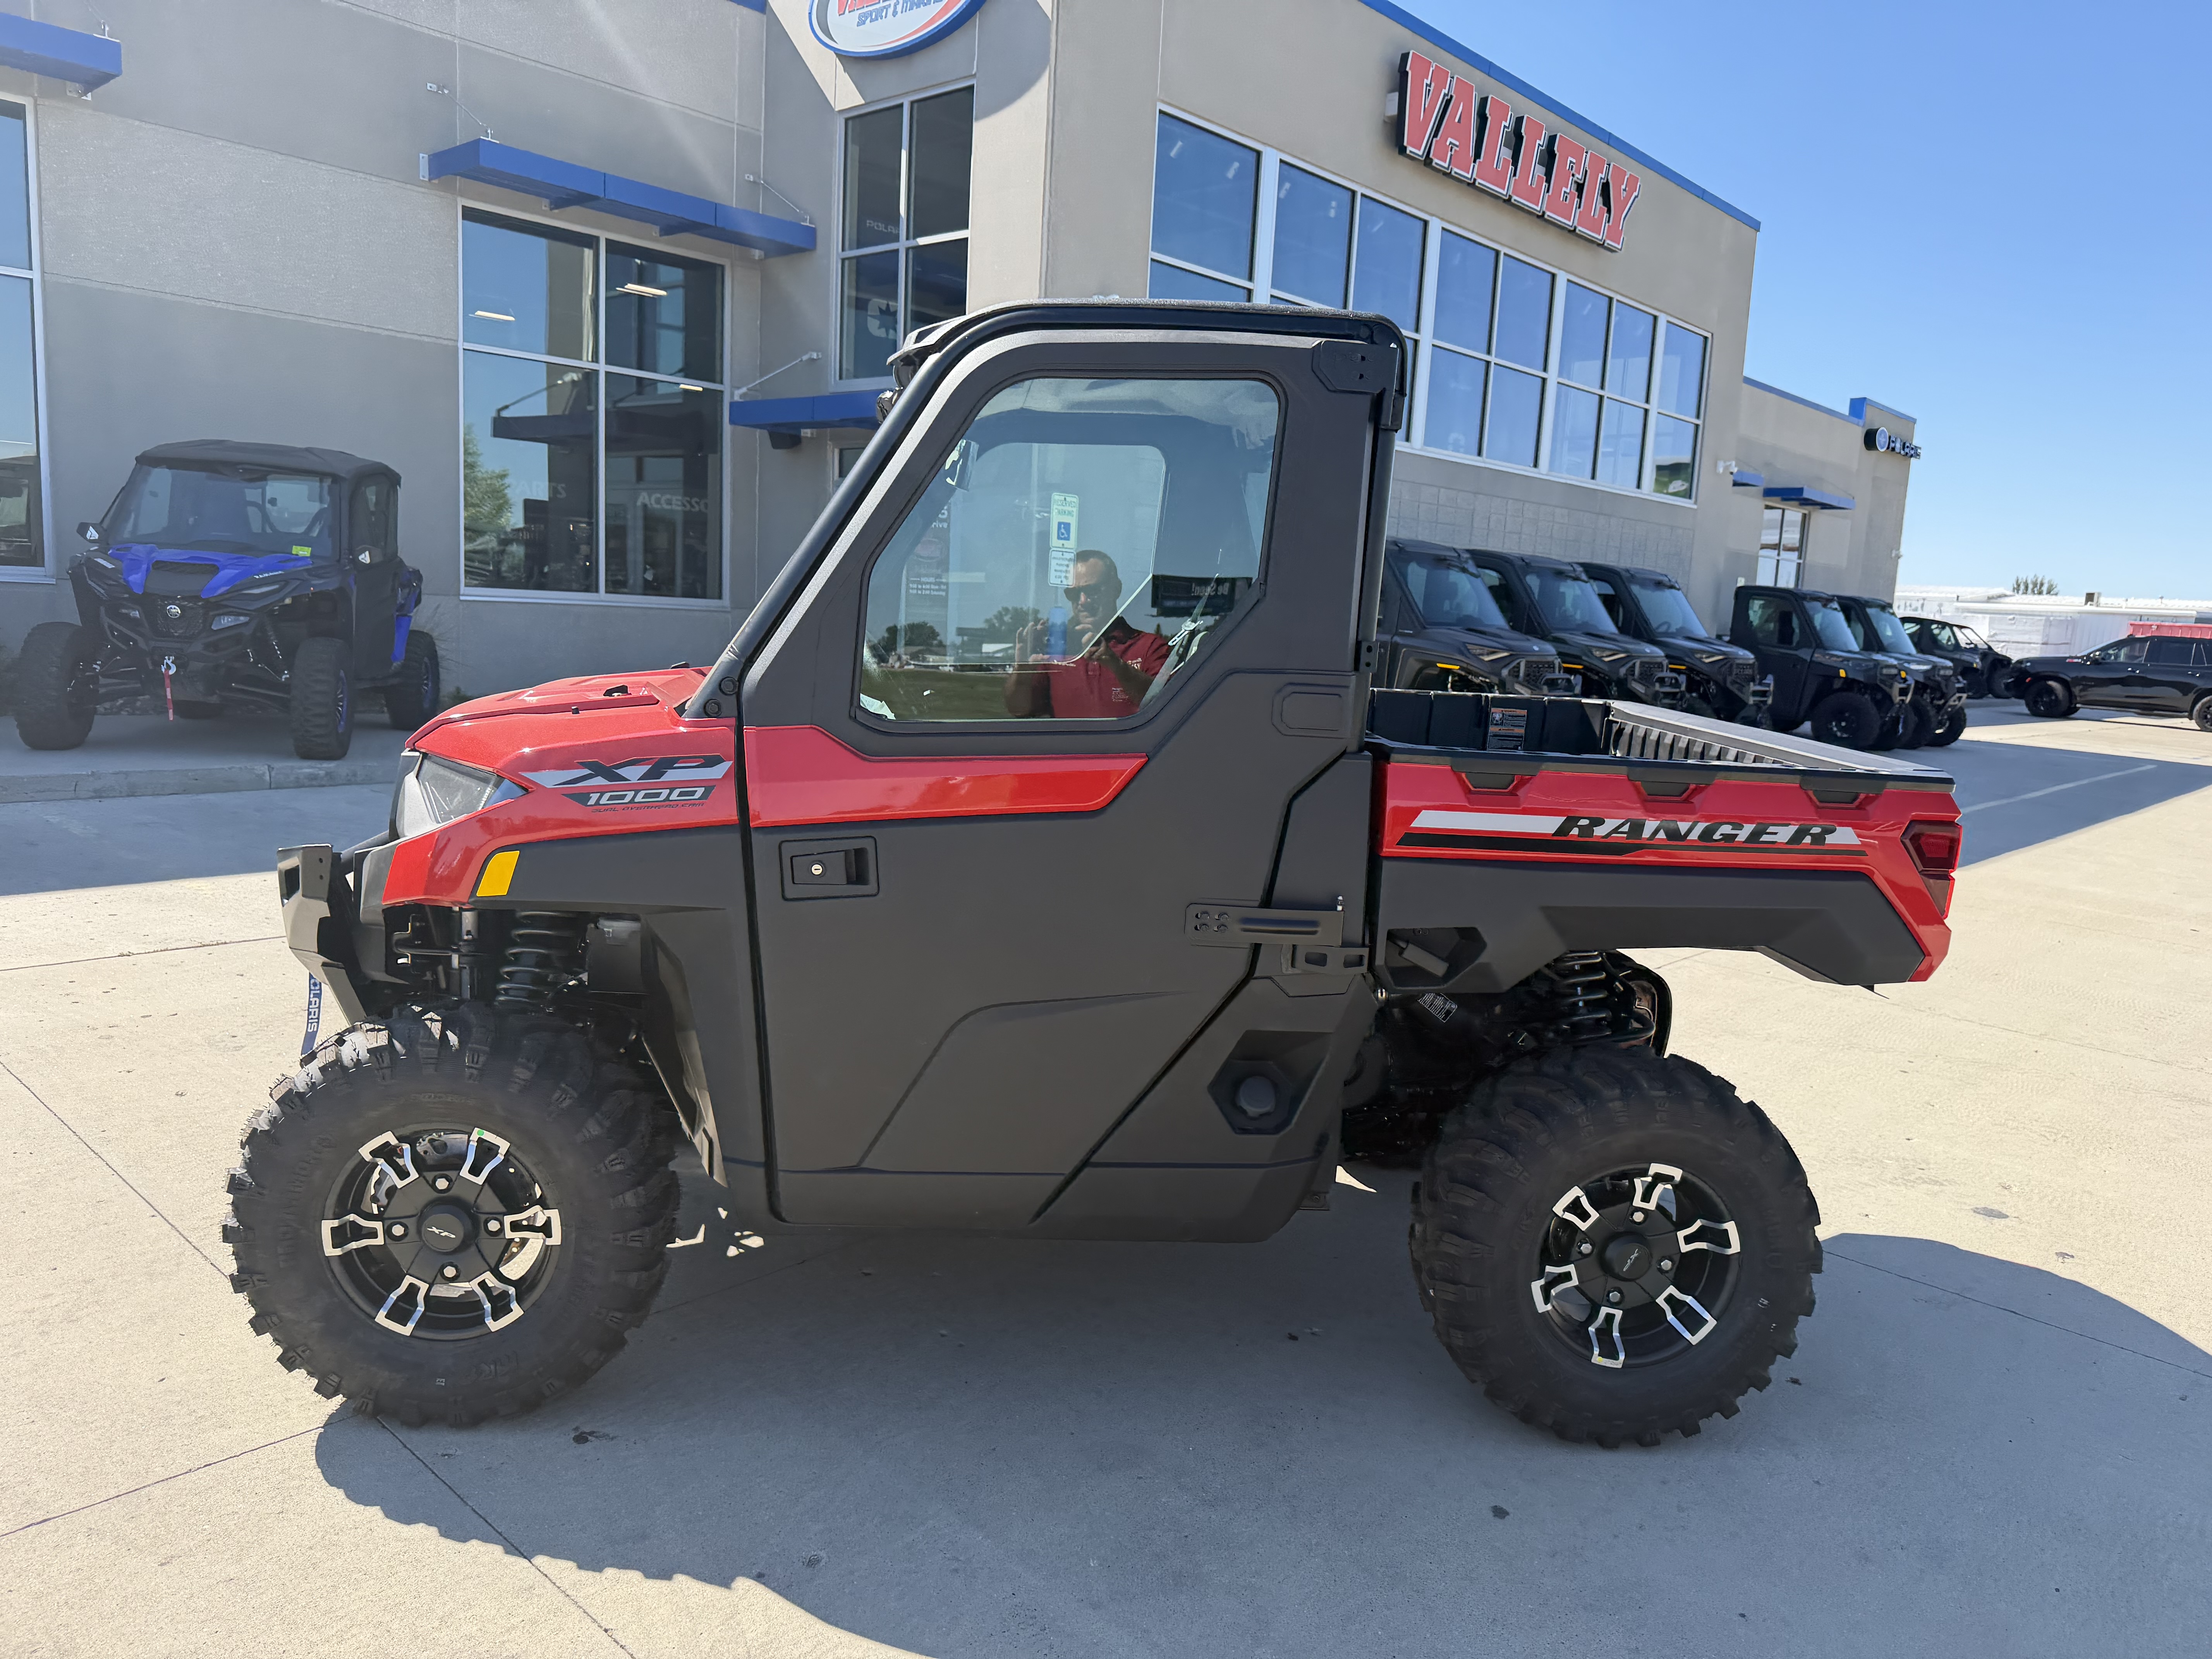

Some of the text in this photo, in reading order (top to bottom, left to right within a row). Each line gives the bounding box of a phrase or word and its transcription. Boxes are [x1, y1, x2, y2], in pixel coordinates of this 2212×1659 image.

[857, 3, 891, 27] SPORT
[1401, 50, 1641, 253] VALLELY
[552, 754, 727, 785] XP
[587, 787, 706, 805] 1000
[1551, 815, 1837, 846] RANGER
[307, 978, 320, 1032] OLARIS
[427, 1226, 456, 1238] XP
